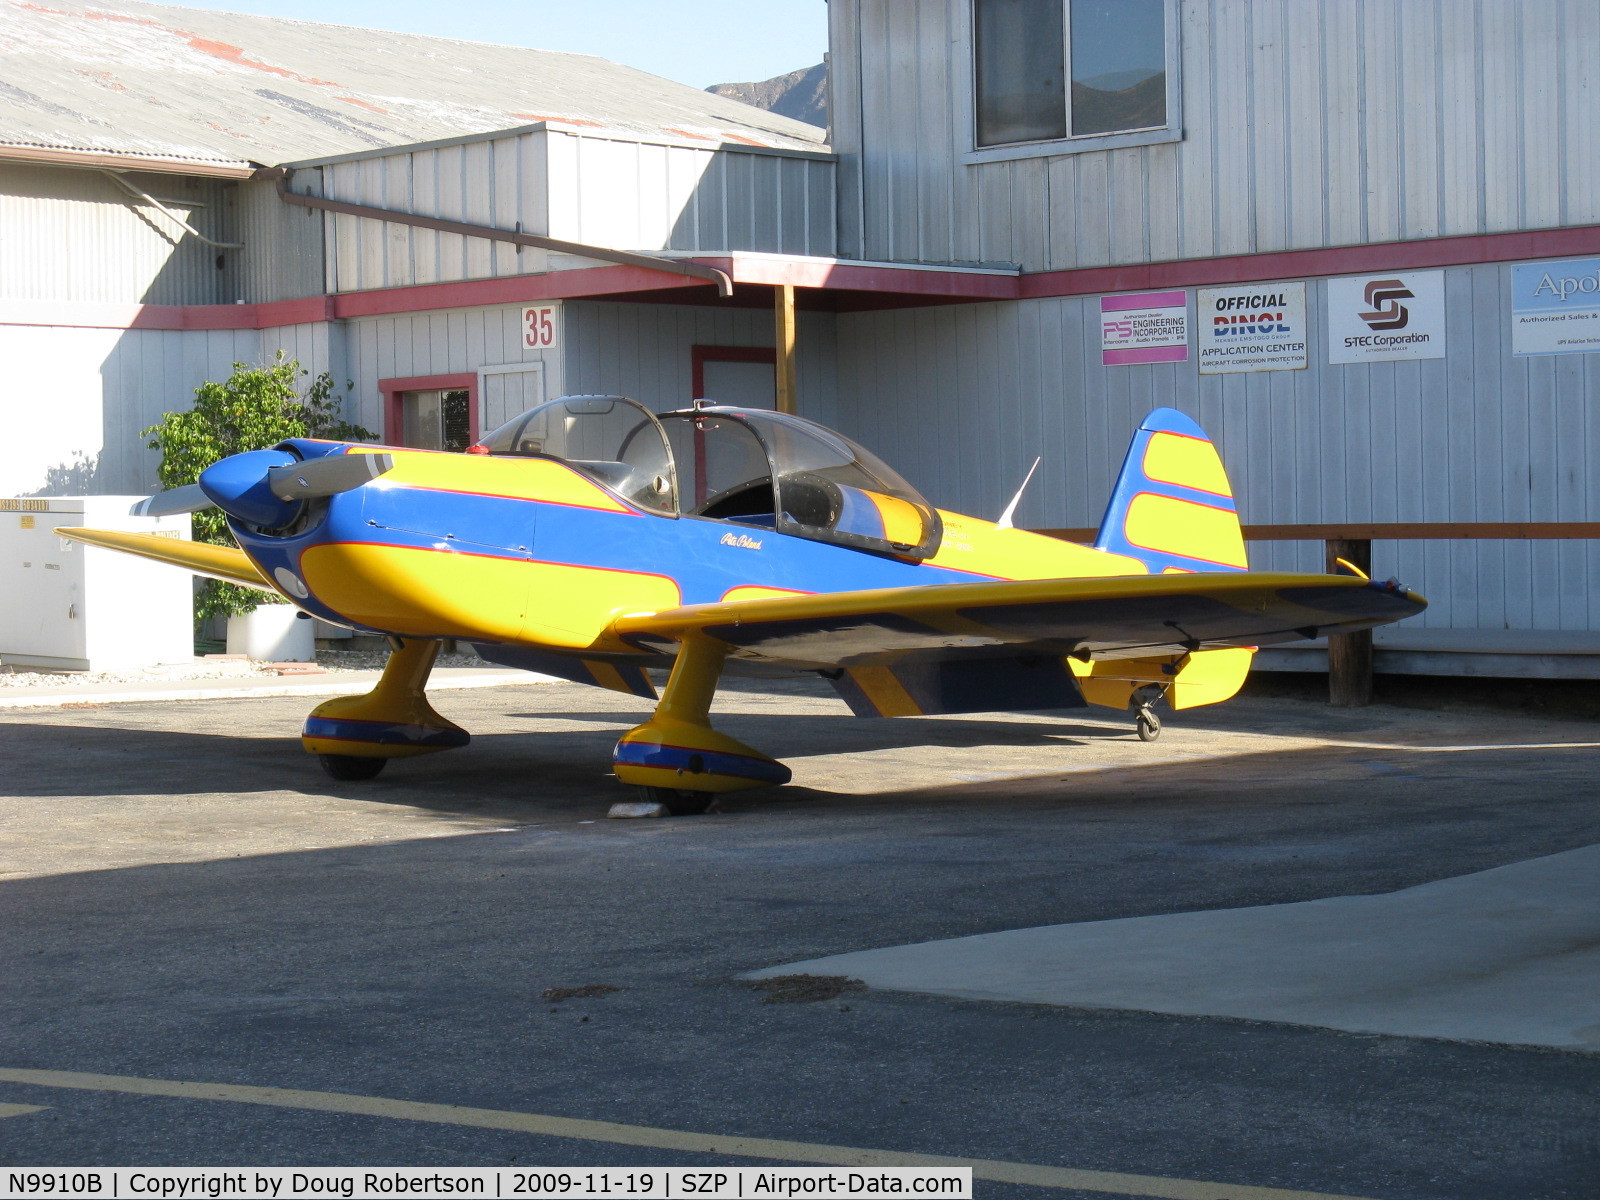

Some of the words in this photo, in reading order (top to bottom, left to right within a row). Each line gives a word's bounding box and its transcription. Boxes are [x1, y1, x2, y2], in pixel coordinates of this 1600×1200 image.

[1215, 294, 1287, 311] OFFICIAL
[1132, 317, 1185, 329] ENGINEERING
[1213, 312, 1291, 337] DINOL
[1519, 315, 1566, 323] Authorized
[525, 308, 553, 347] 35
[1103, 320, 1133, 339] PS
[1132, 326, 1185, 337] INCORPORATED
[1344, 336, 1372, 347] S-TEC
[1373, 333, 1430, 347] Corporation
[1201, 345, 1264, 357] APPLICATION
[1266, 343, 1305, 353] CENTER
